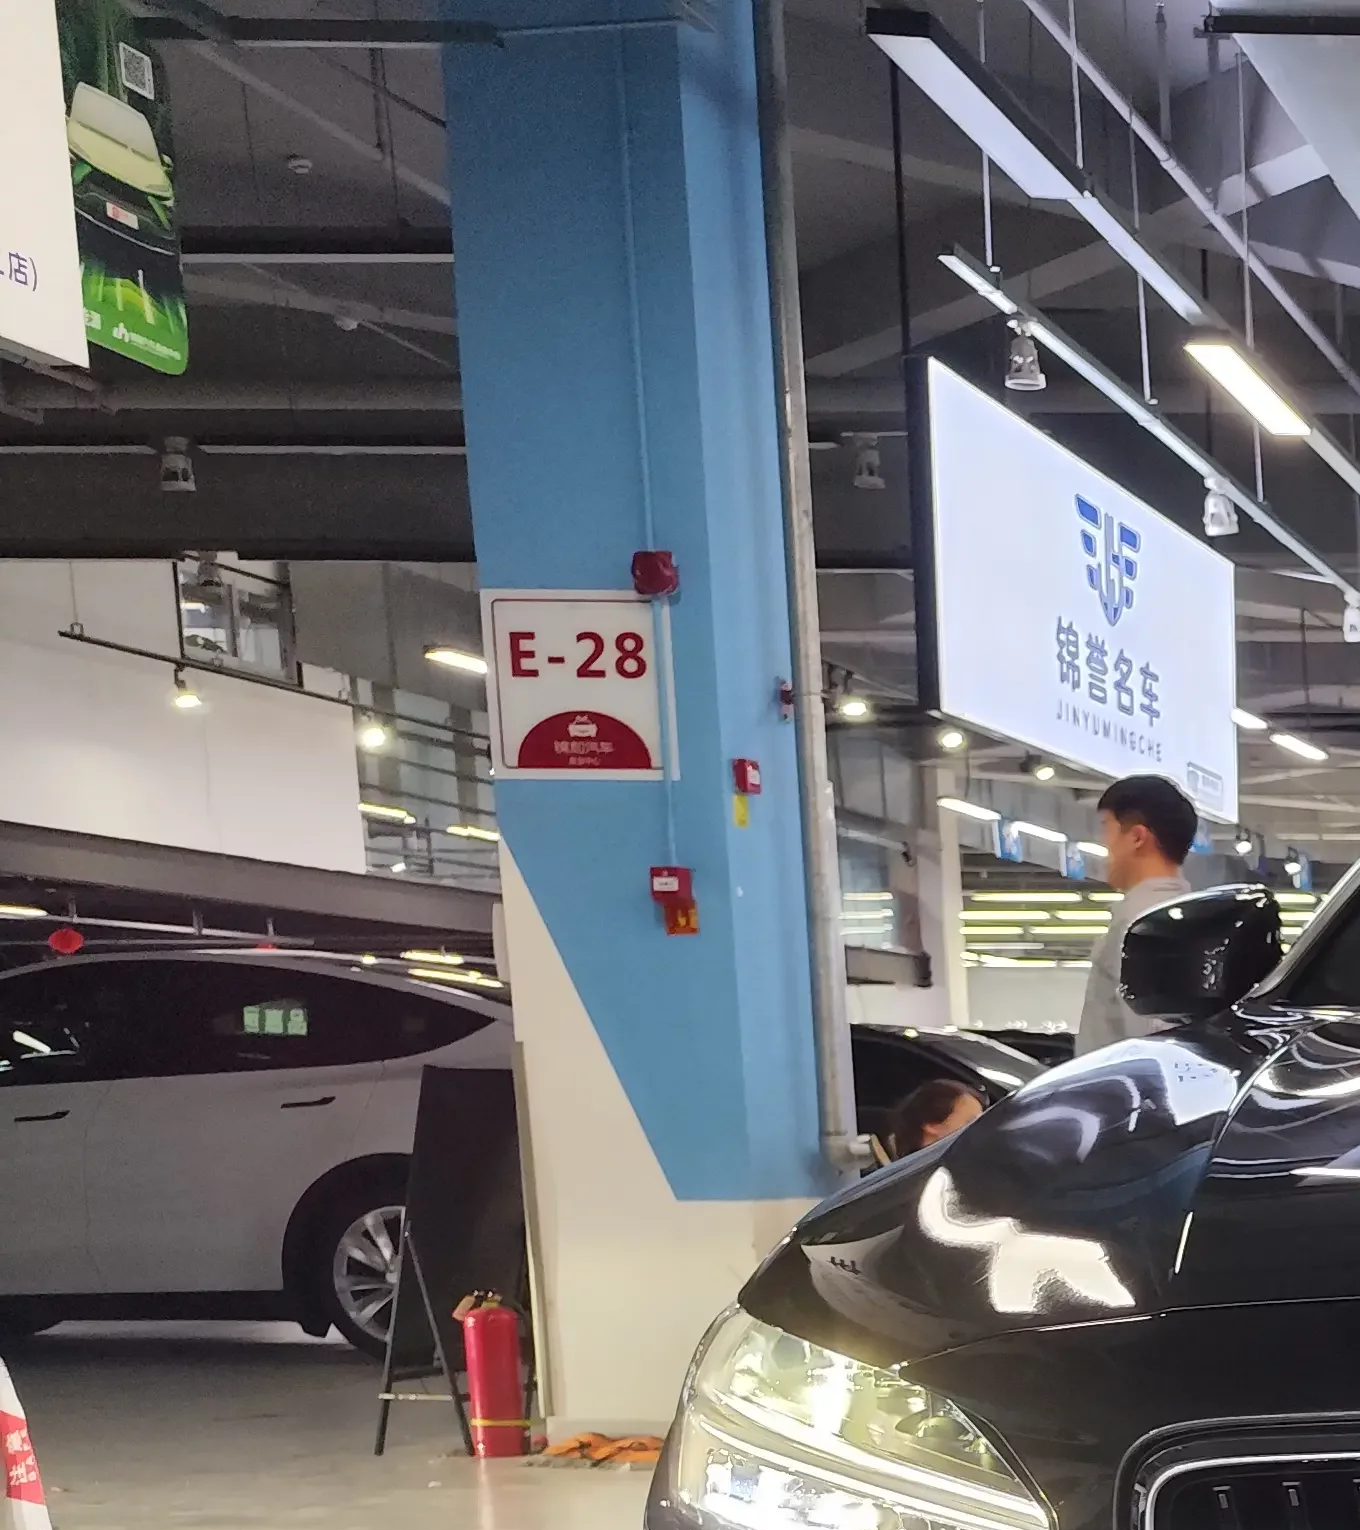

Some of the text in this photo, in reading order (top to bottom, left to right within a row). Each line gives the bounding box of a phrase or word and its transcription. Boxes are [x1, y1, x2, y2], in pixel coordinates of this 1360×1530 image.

[0, 252, 37, 291] 店)
[509, 631, 647, 679] E-28
[1056, 615, 1161, 727] 锦誉名车
[1056, 699, 1162, 762] JINYUMINGCHE
